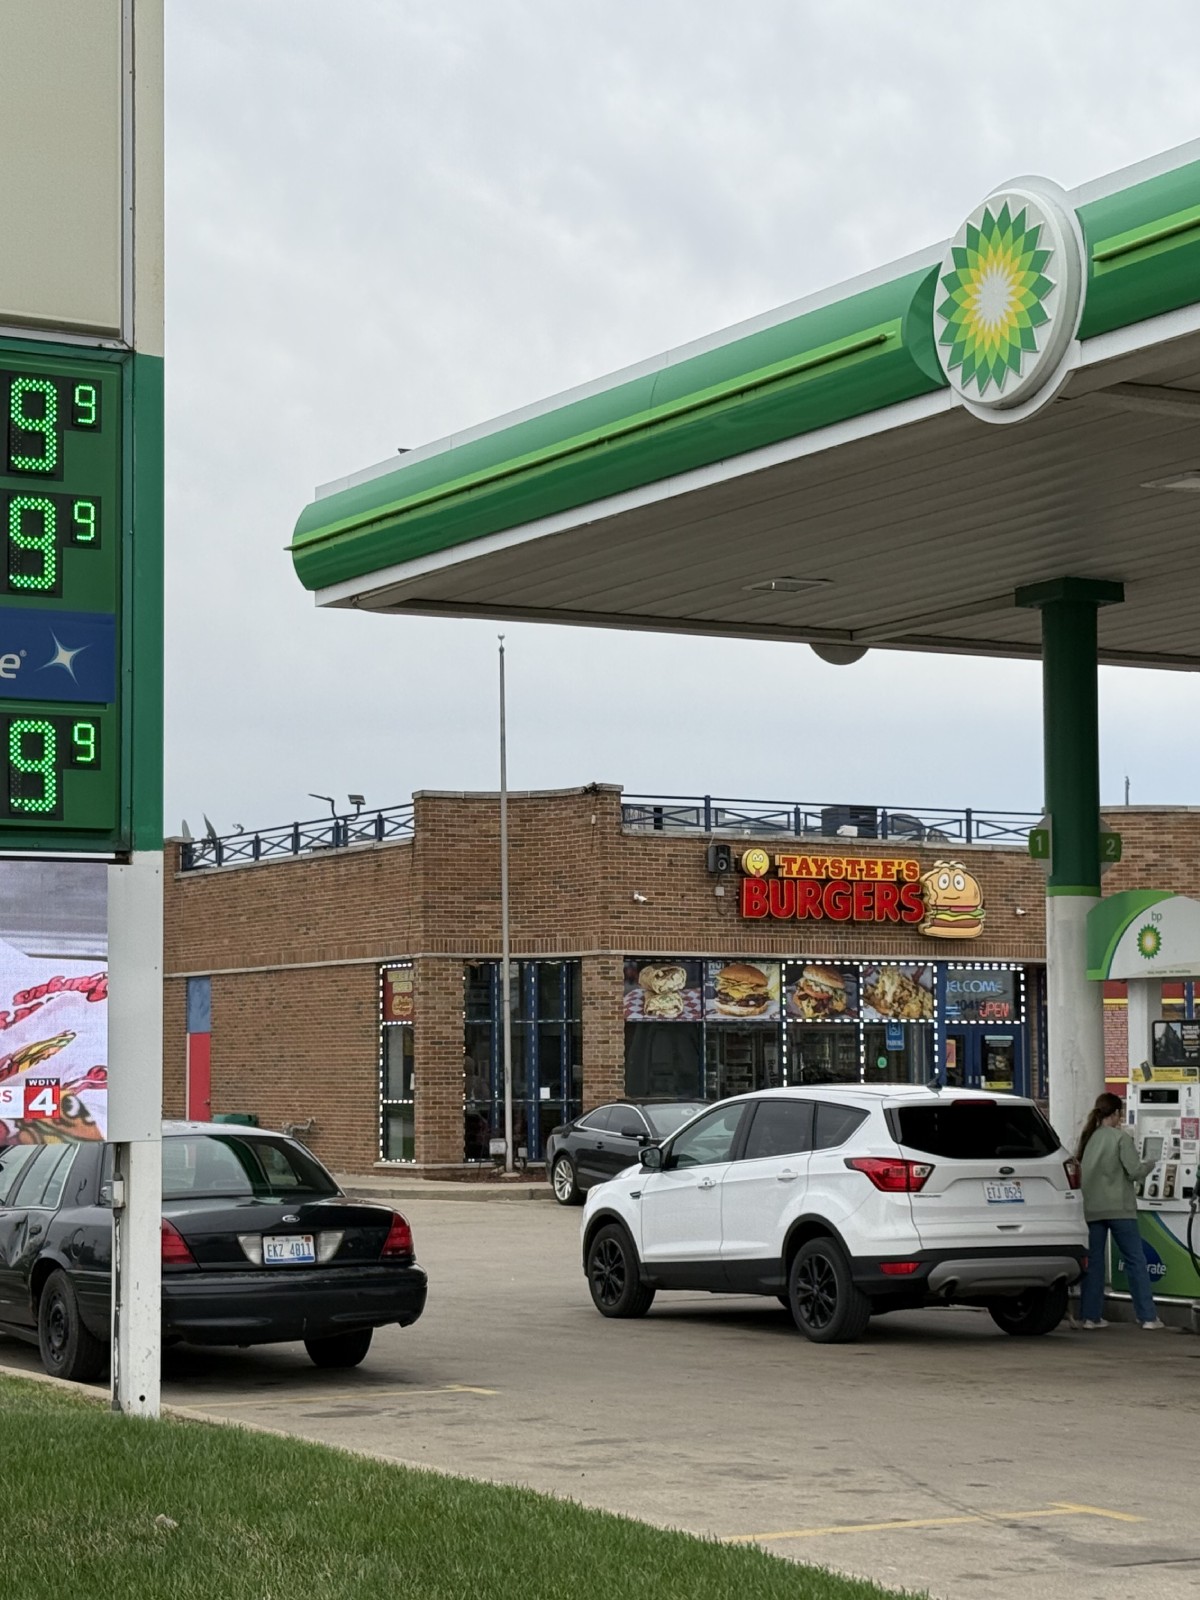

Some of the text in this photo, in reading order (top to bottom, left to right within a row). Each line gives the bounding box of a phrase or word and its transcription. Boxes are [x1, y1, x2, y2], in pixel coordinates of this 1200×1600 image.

[1035, 835, 1043, 852] 1
[1105, 838, 1116, 855] 2
[780, 855, 920, 881] TAYSTEE'S
[742, 878, 926, 923] BURGERS
[1151, 911, 1163, 923] bp
[1186, 1087, 1192, 1097] 1
[28, 1087, 58, 1117] 4
[267, 1243, 284, 1258] EKZ
